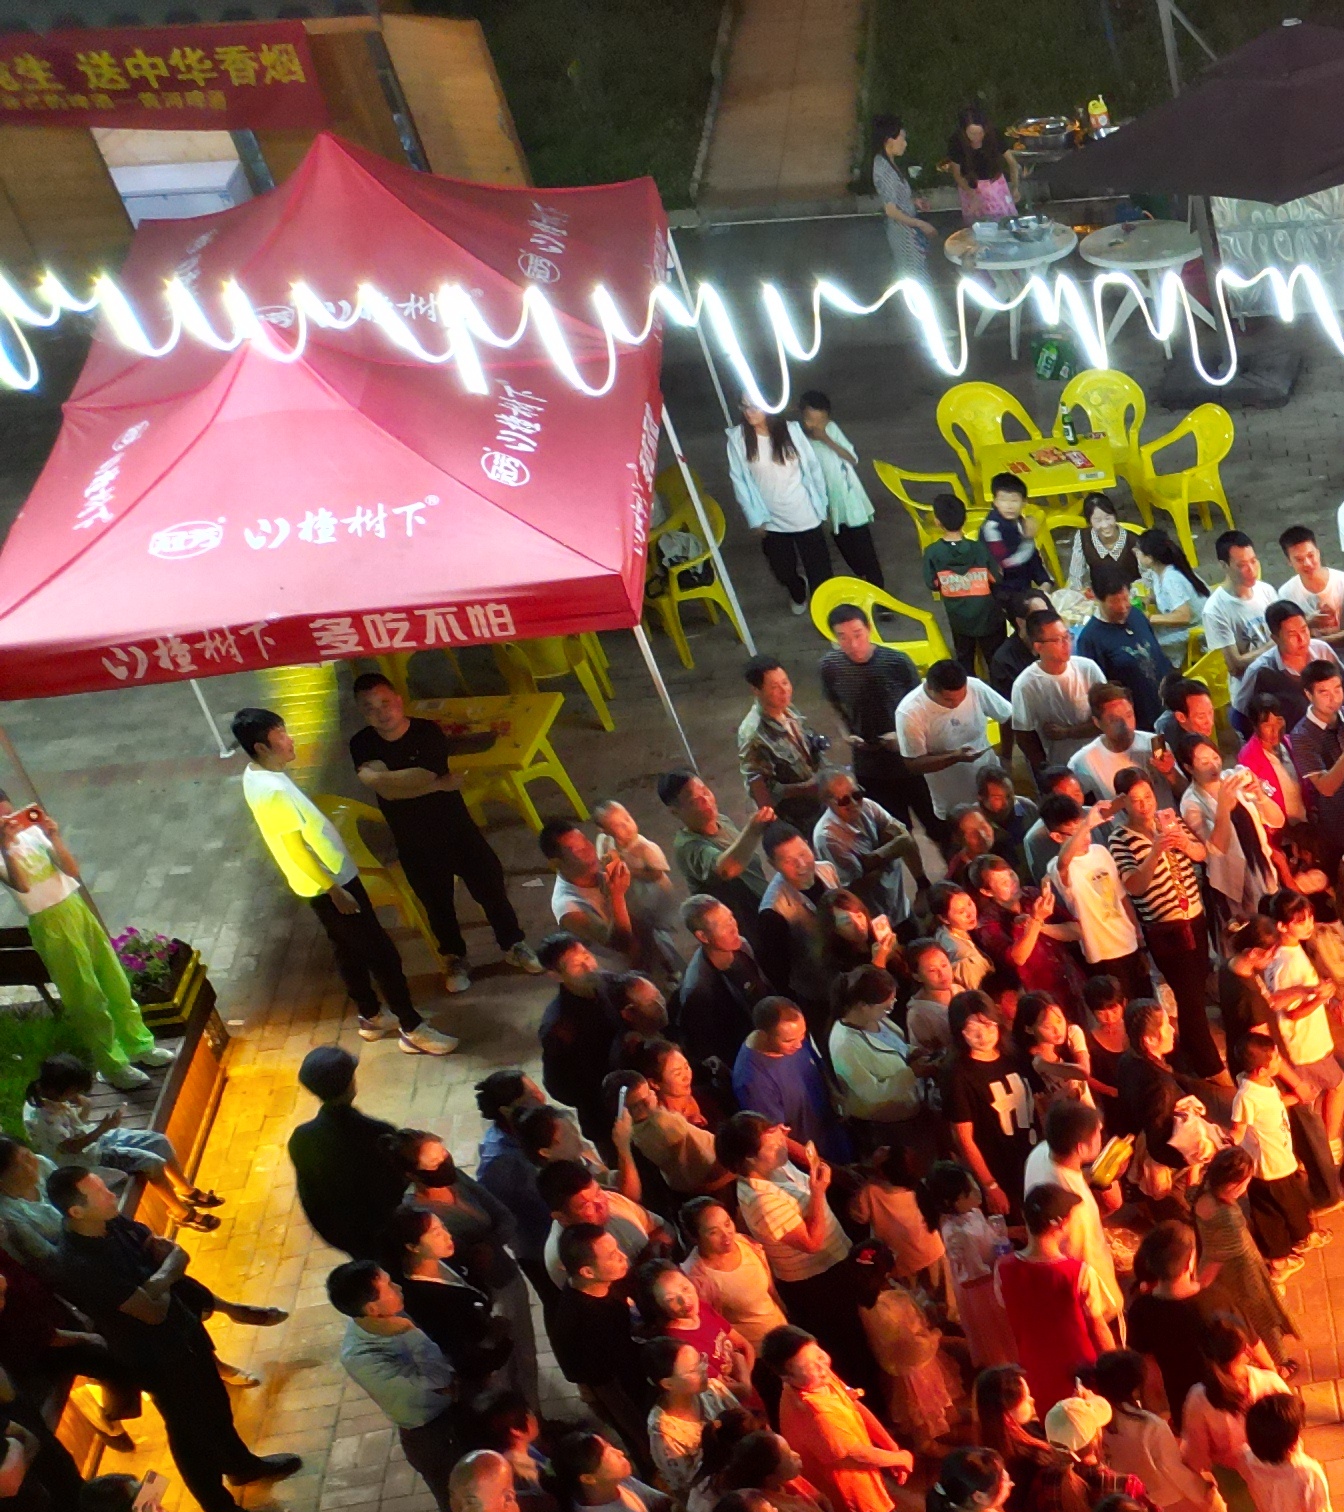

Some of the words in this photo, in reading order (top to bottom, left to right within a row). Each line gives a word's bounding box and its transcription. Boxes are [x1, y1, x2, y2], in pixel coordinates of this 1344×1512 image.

[76, 43, 306, 89] 送中华香烟
[243, 501, 427, 551] 山楂树下
[102, 621, 276, 680] 山楂树下
[308, 602, 516, 656] 多吃不怕
